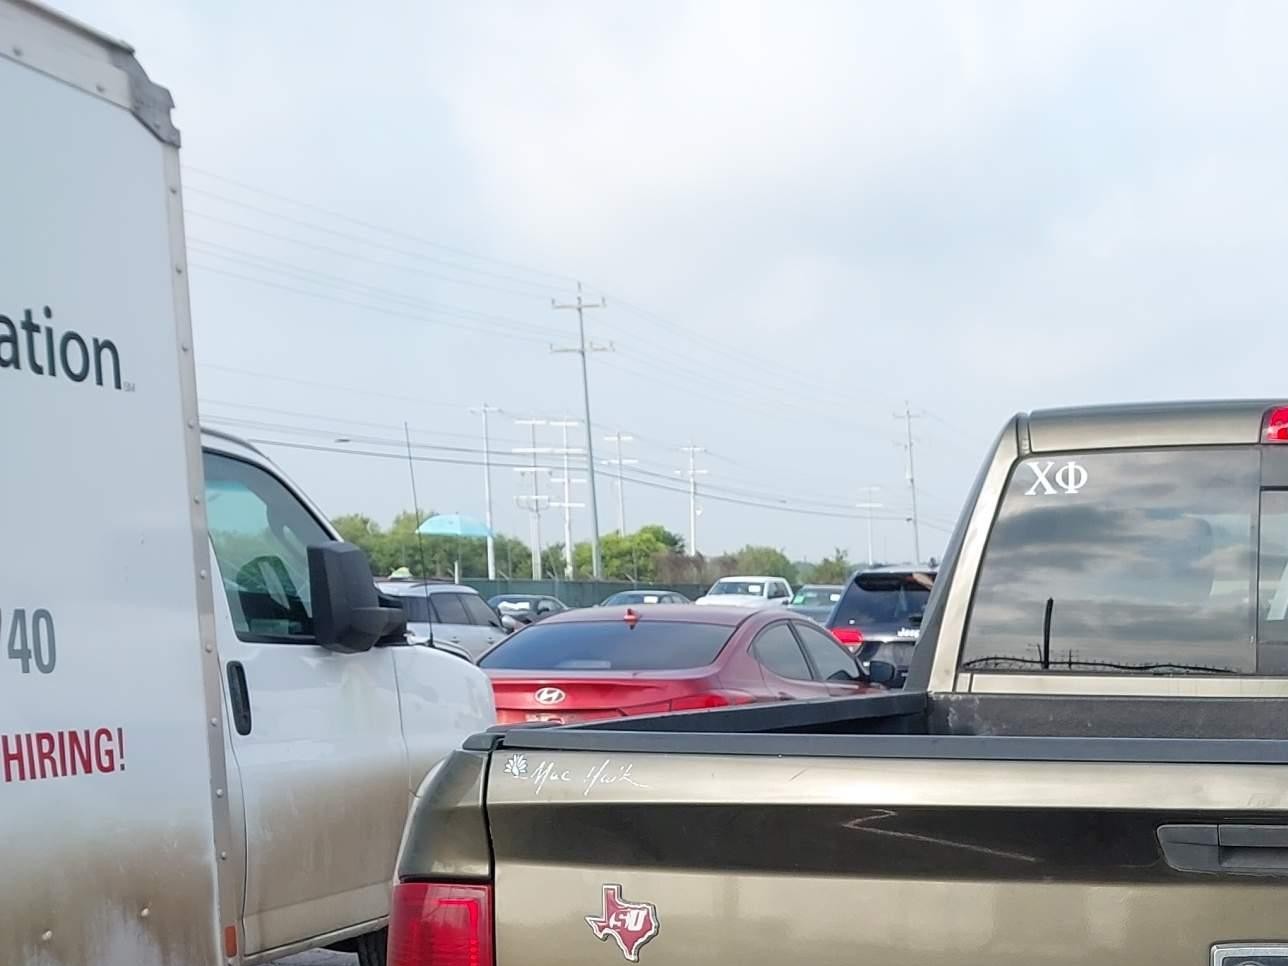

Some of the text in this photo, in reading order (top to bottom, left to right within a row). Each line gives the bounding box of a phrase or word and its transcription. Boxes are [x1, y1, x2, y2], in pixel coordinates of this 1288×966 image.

[0, 305, 121, 389] ation
[0, 608, 56, 674] 40
[1, 728, 125, 782] HIRING!
